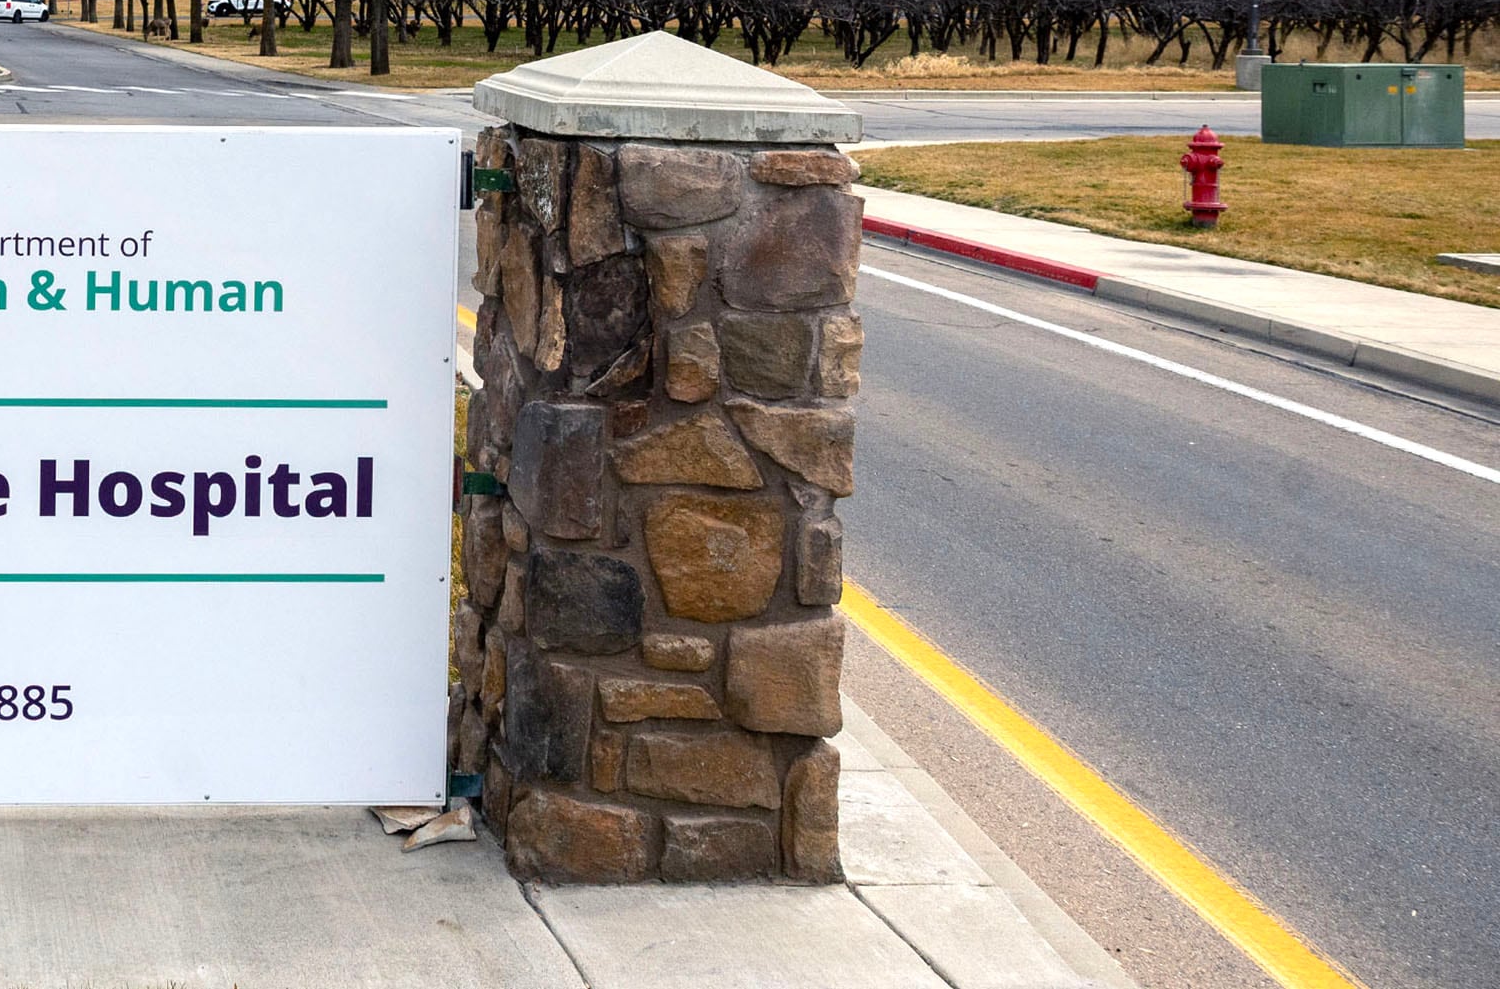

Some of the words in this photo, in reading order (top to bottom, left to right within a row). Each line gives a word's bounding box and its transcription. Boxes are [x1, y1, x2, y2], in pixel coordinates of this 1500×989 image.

[120, 229, 154, 258] of
[26, 269, 68, 312] &
[85, 270, 285, 313] Human
[38, 455, 375, 537] Hospital
